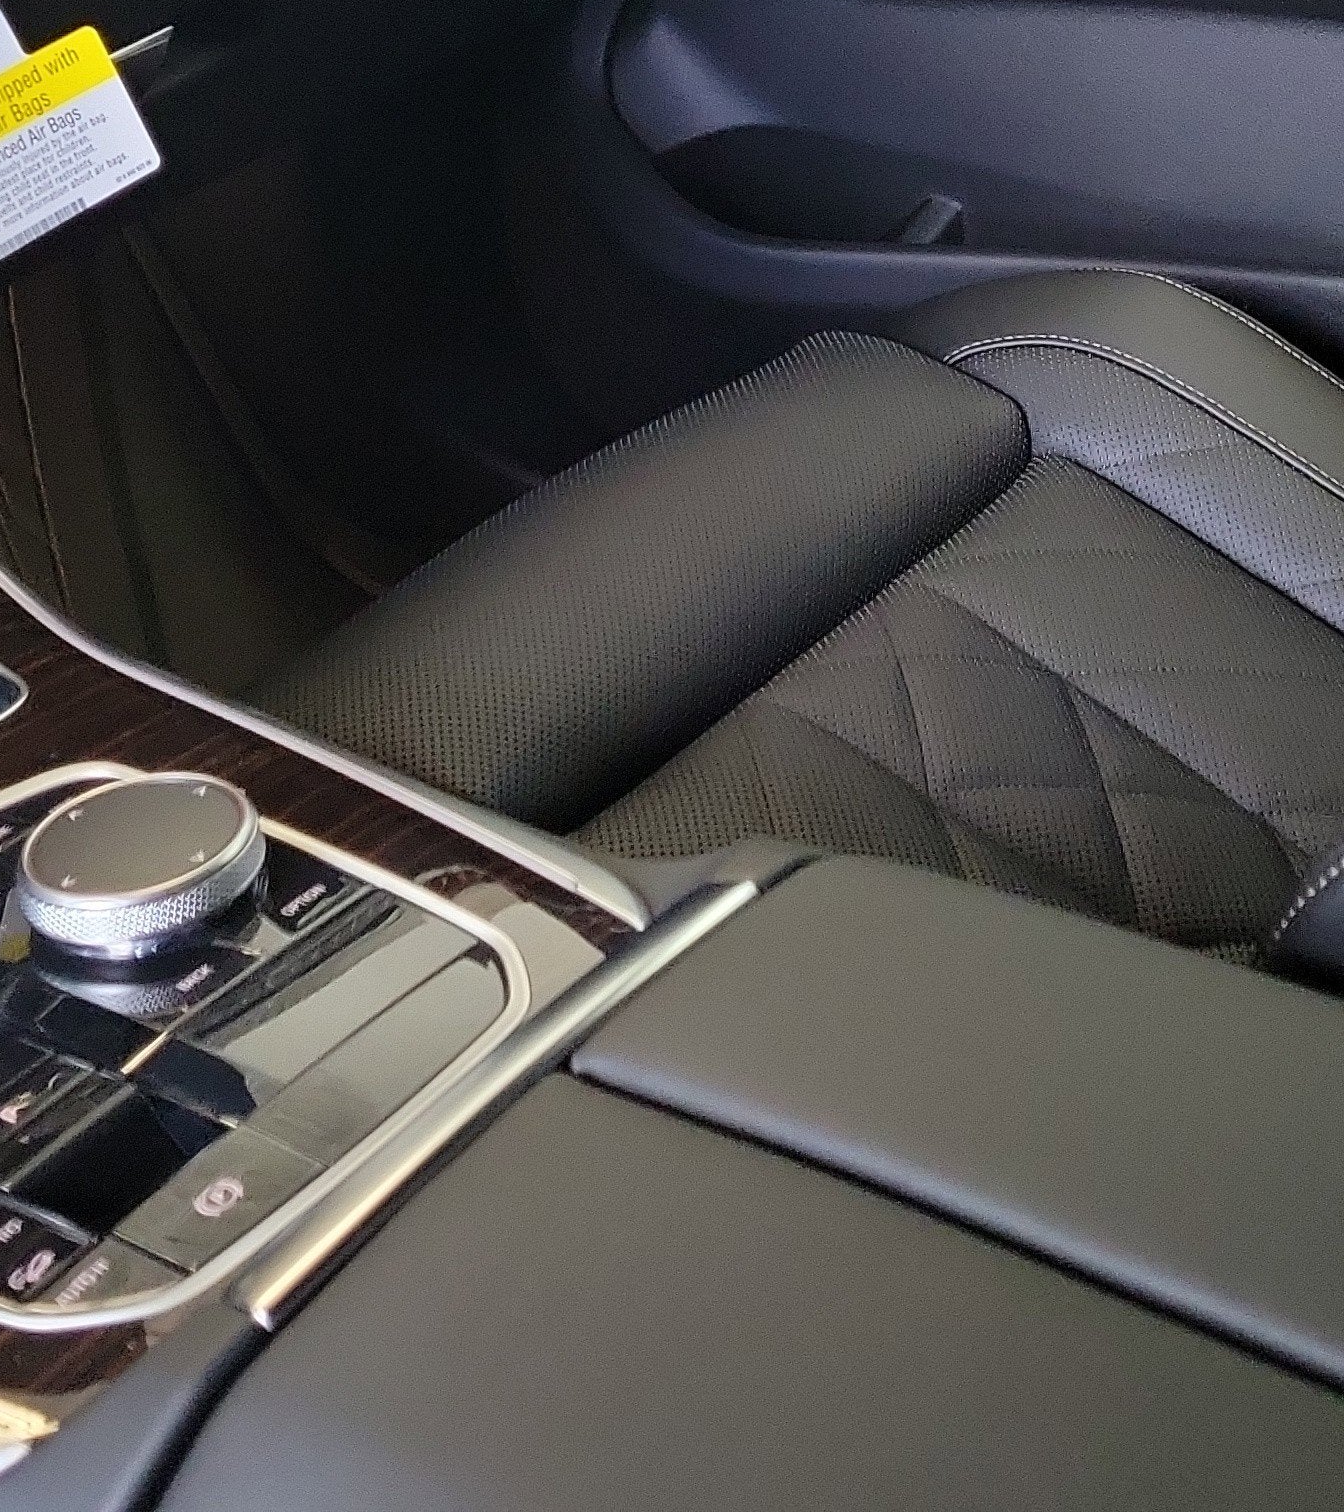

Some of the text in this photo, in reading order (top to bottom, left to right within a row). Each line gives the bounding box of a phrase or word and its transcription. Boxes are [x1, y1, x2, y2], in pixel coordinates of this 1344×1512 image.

[43, 47, 79, 75] with
[9, 92, 51, 122] Bags
[27, 125, 46, 145] Air
[46, 108, 81, 133] Bags
